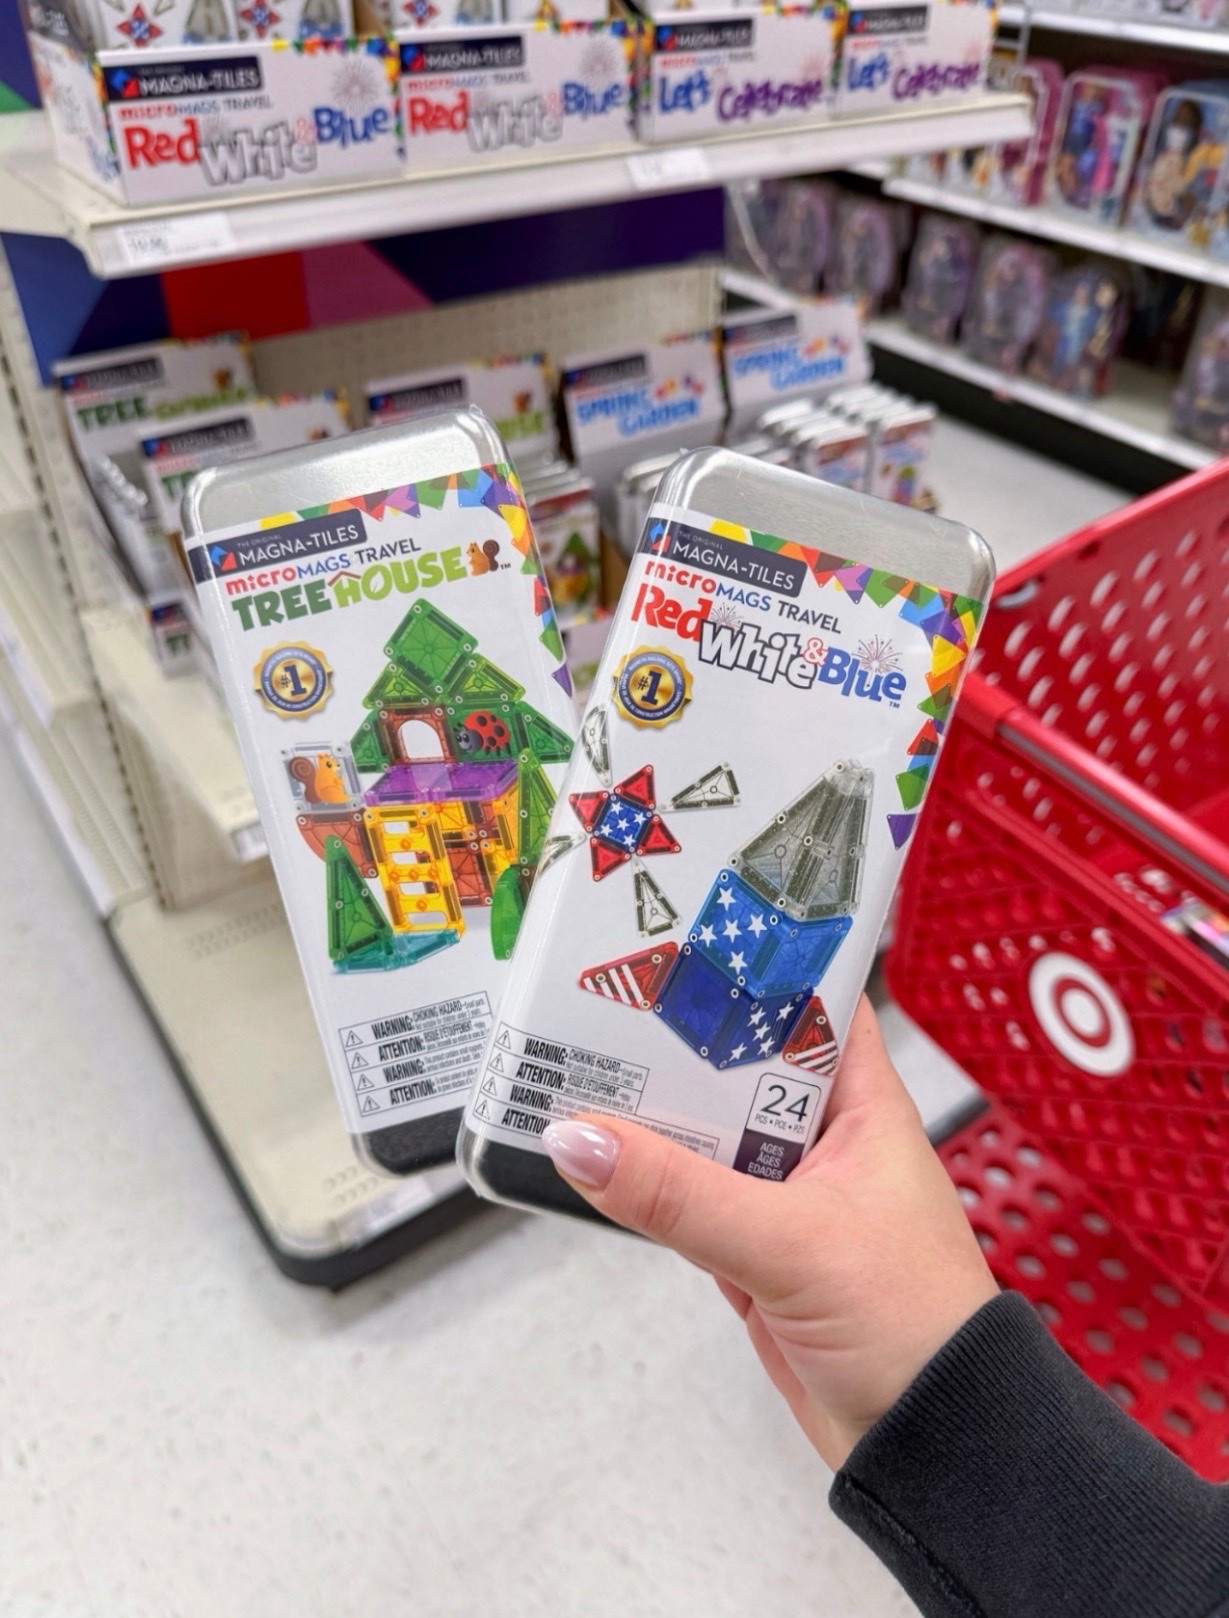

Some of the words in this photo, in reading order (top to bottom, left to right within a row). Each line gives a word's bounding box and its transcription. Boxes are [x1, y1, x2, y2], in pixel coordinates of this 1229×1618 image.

[139, 67, 260, 96] MAGNA-TILES
[409, 91, 468, 135] Red
[561, 81, 623, 119] Blue
[123, 118, 200, 169] Red
[200, 122, 318, 187] White
[314, 105, 388, 147] Blue
[239, 524, 360, 566] MAGNA-TILES
[225, 553, 351, 596] microMAGS
[355, 537, 421, 565] TRAVEL
[672, 541, 795, 591] MAGNA-TILES
[645, 560, 771, 611] microMAGS
[778, 600, 841, 634] TRAVEL
[631, 583, 713, 642] Red
[699, 619, 817, 689] White
[803, 637, 828, 666] &
[818, 645, 906, 702] Blue
[280, 664, 308, 696] #1
[637, 670, 662, 705] #1
[371, 1014, 414, 1040] WARNING:
[377, 1035, 425, 1062] ATTENTION:
[523, 1037, 569, 1066] WARNING:
[568, 1048, 597, 1067] CHOKING
[382, 1058, 426, 1083] WARNING:
[515, 1062, 567, 1091] ATTENTION:
[389, 1079, 437, 1106] ATTENTION:
[509, 1085, 555, 1114] WARNING:
[760, 1084, 810, 1122] 24
[755, 1113, 768, 1126] PCS
[774, 1118, 787, 1131] PCE
[793, 1124, 805, 1135] PZS
[760, 1142, 785, 1157] AGES
[748, 1162, 784, 1180] EDADES
